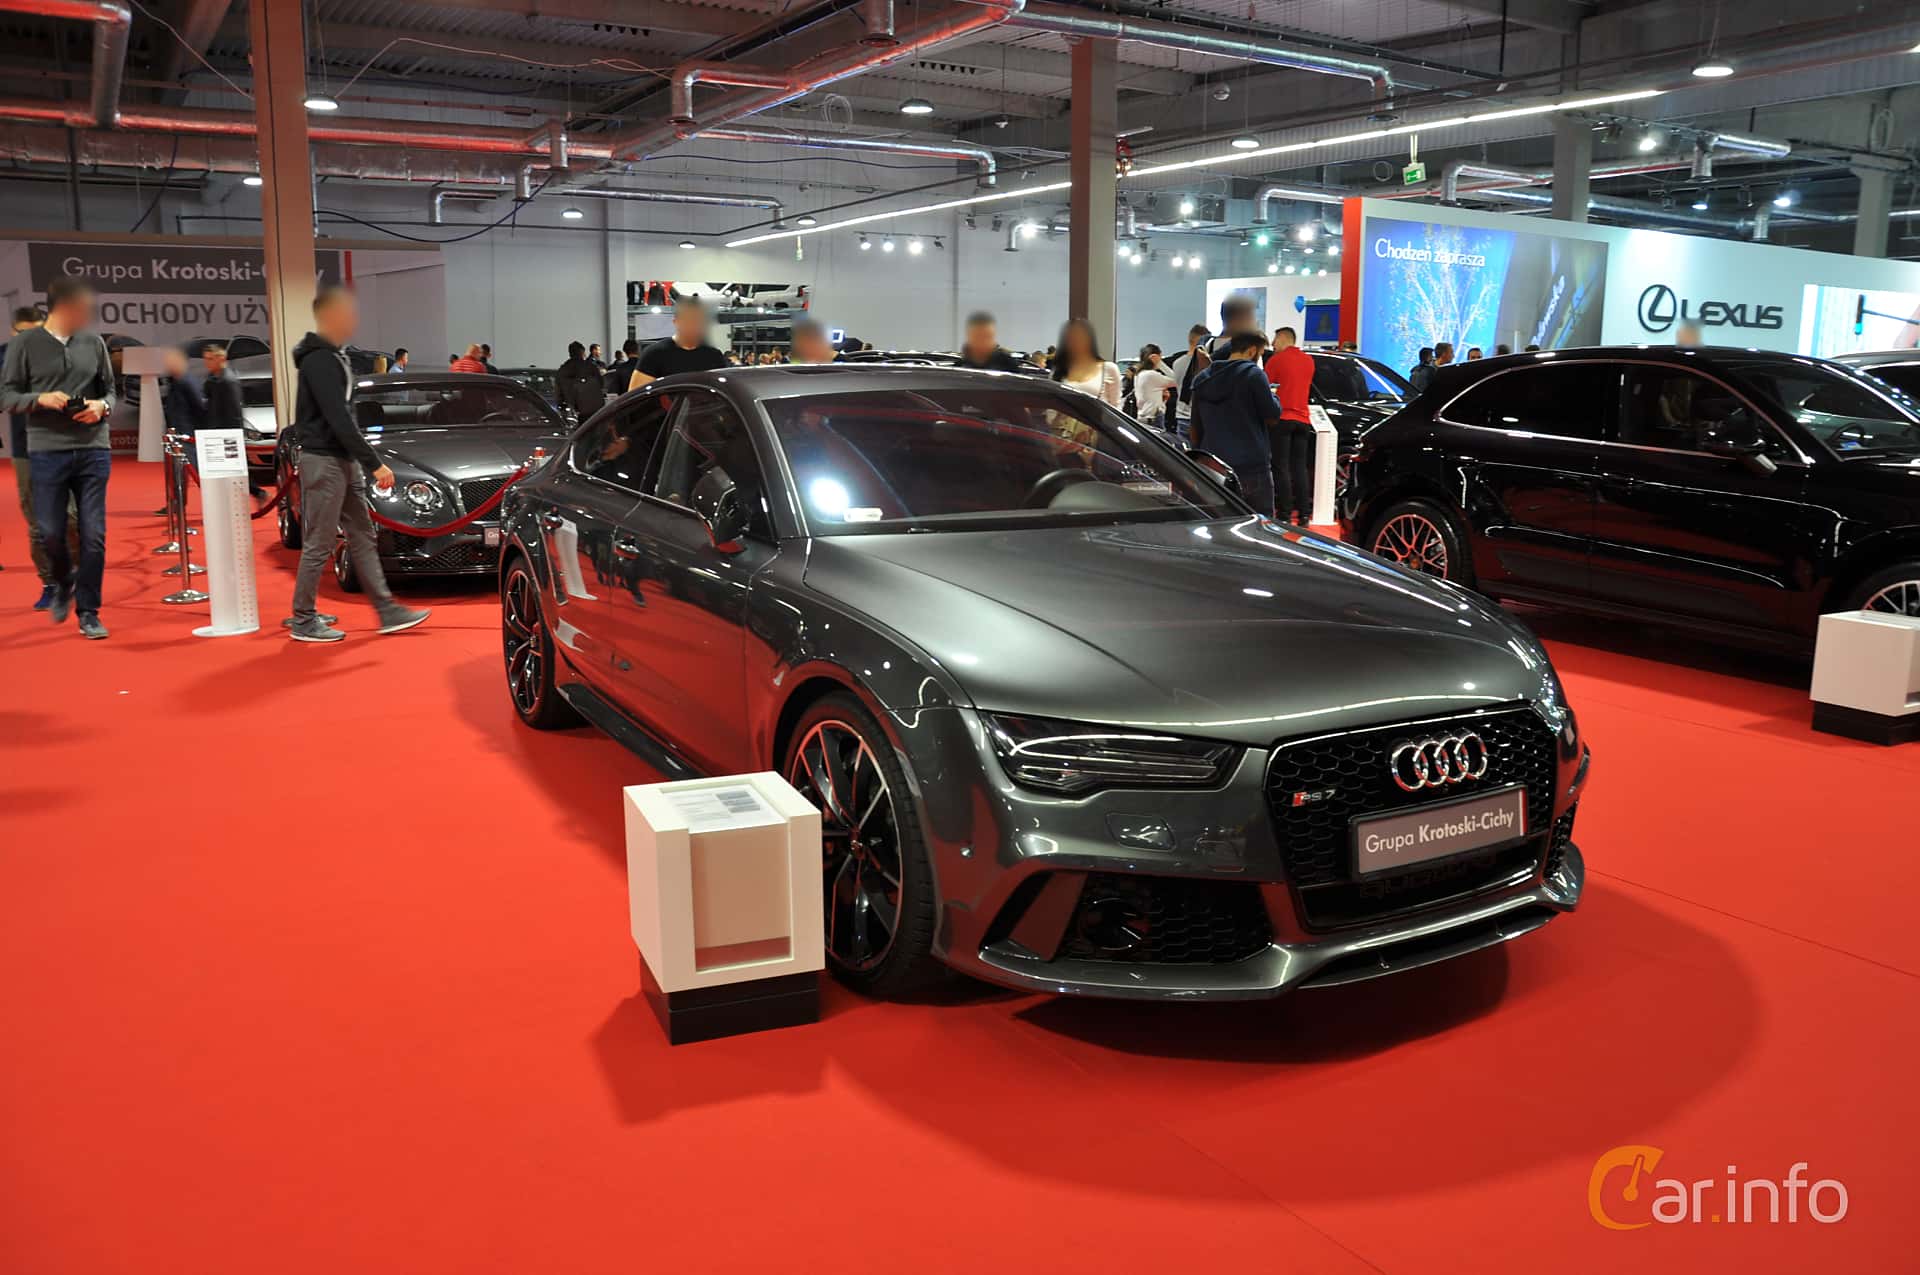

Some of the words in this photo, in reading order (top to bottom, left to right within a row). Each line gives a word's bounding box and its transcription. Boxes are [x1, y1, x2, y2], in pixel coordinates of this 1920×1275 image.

[62, 256, 143, 284] Grupa
[1433, 250, 1486, 269] zaprasza
[33, 302, 213, 324] SOCHODY
[1365, 833, 1415, 853] Grupa
[1418, 808, 1514, 843] Krotoski-Cichy
